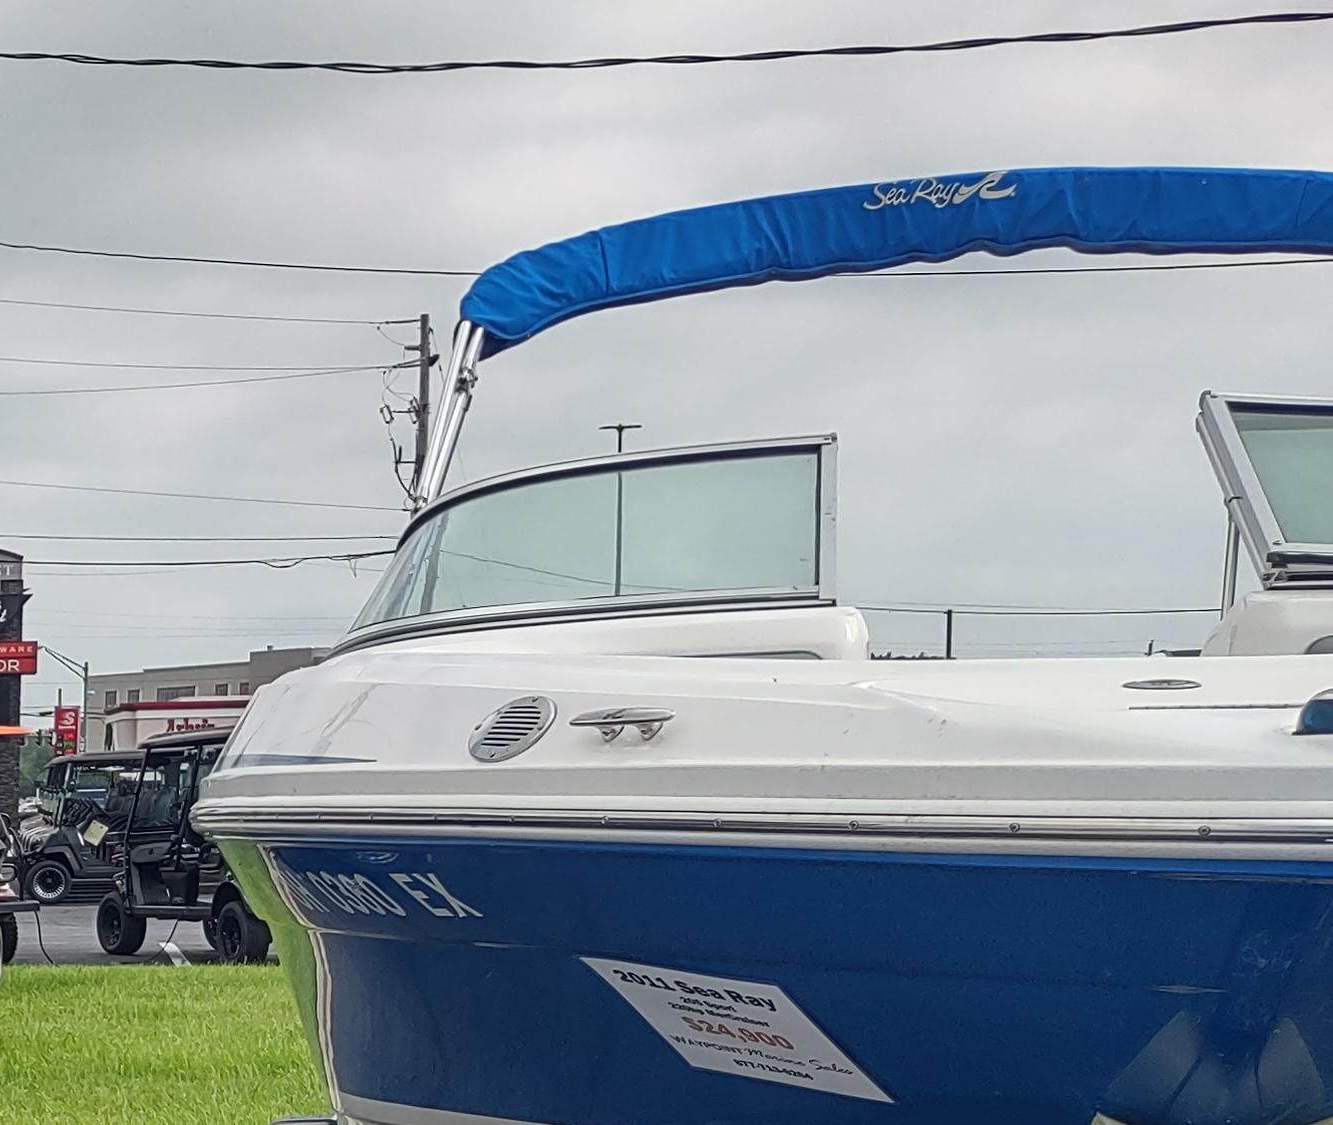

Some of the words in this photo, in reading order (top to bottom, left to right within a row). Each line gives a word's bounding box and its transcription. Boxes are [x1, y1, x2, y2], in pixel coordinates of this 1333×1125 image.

[863, 181, 909, 210] Sea
[909, 177, 962, 208] Ray
[388, 873, 484, 917] EX
[613, 969, 676, 992] 2011
[674, 980, 727, 1001] Sea
[724, 989, 777, 1012] Ray
[681, 1016, 795, 1050] $24,900
